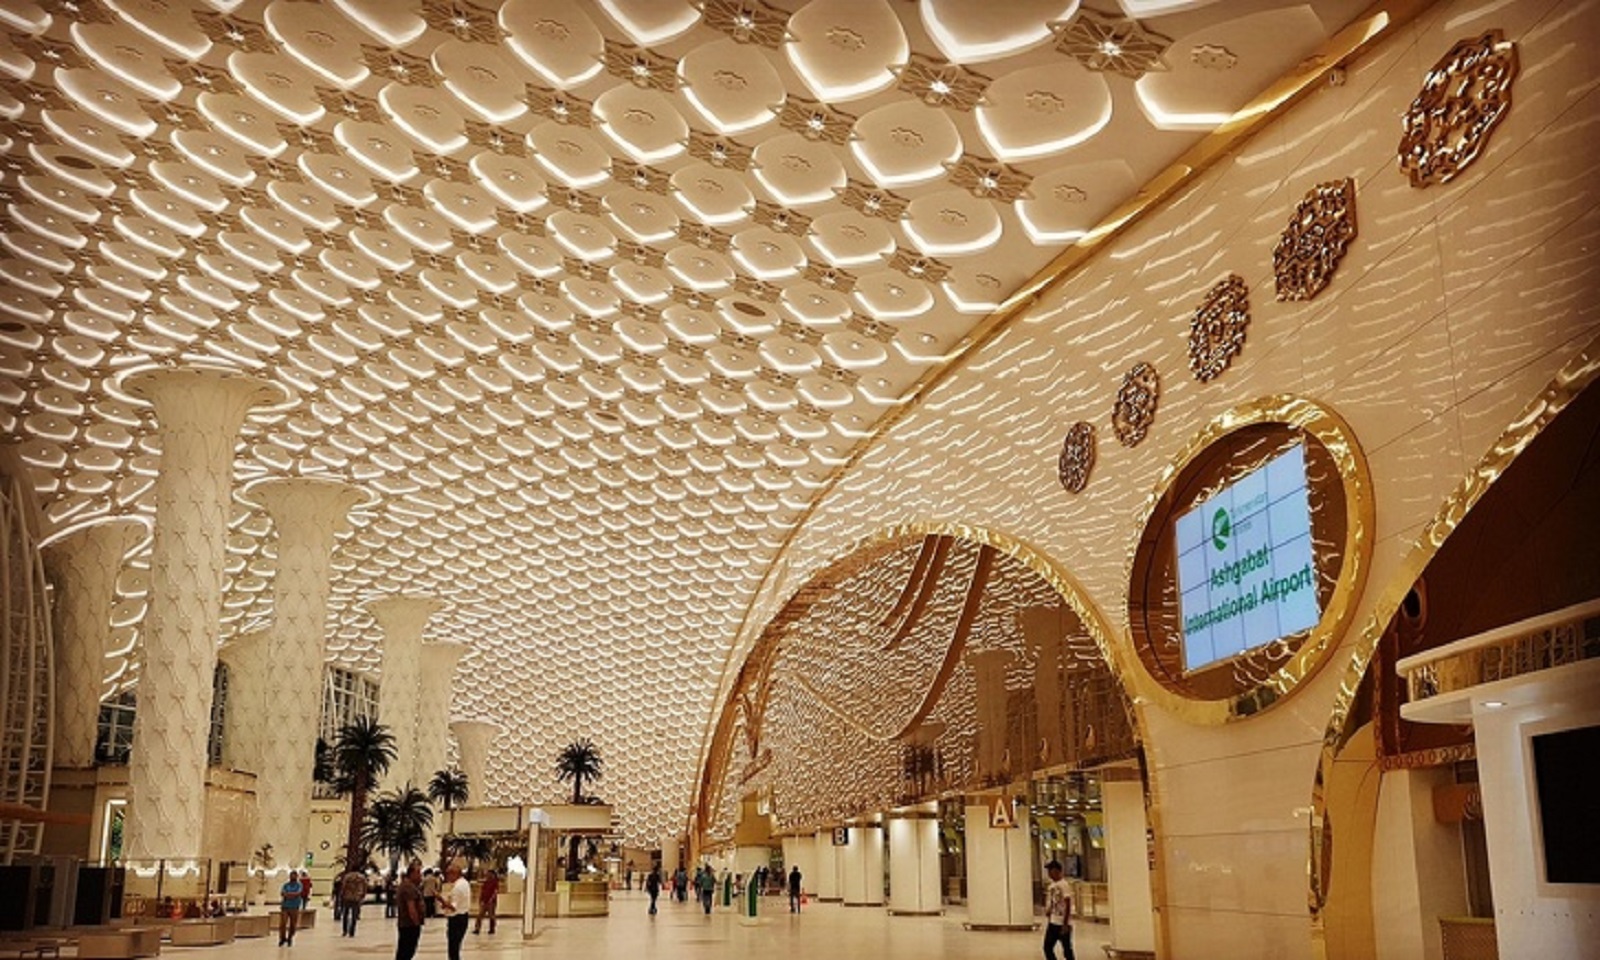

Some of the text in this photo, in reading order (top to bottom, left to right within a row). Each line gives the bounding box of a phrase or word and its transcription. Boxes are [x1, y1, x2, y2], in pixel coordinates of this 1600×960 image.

[1211, 542, 1269, 591] Ashgabat
[1184, 562, 1312, 635] International Airport
[992, 798, 1010, 827] A
